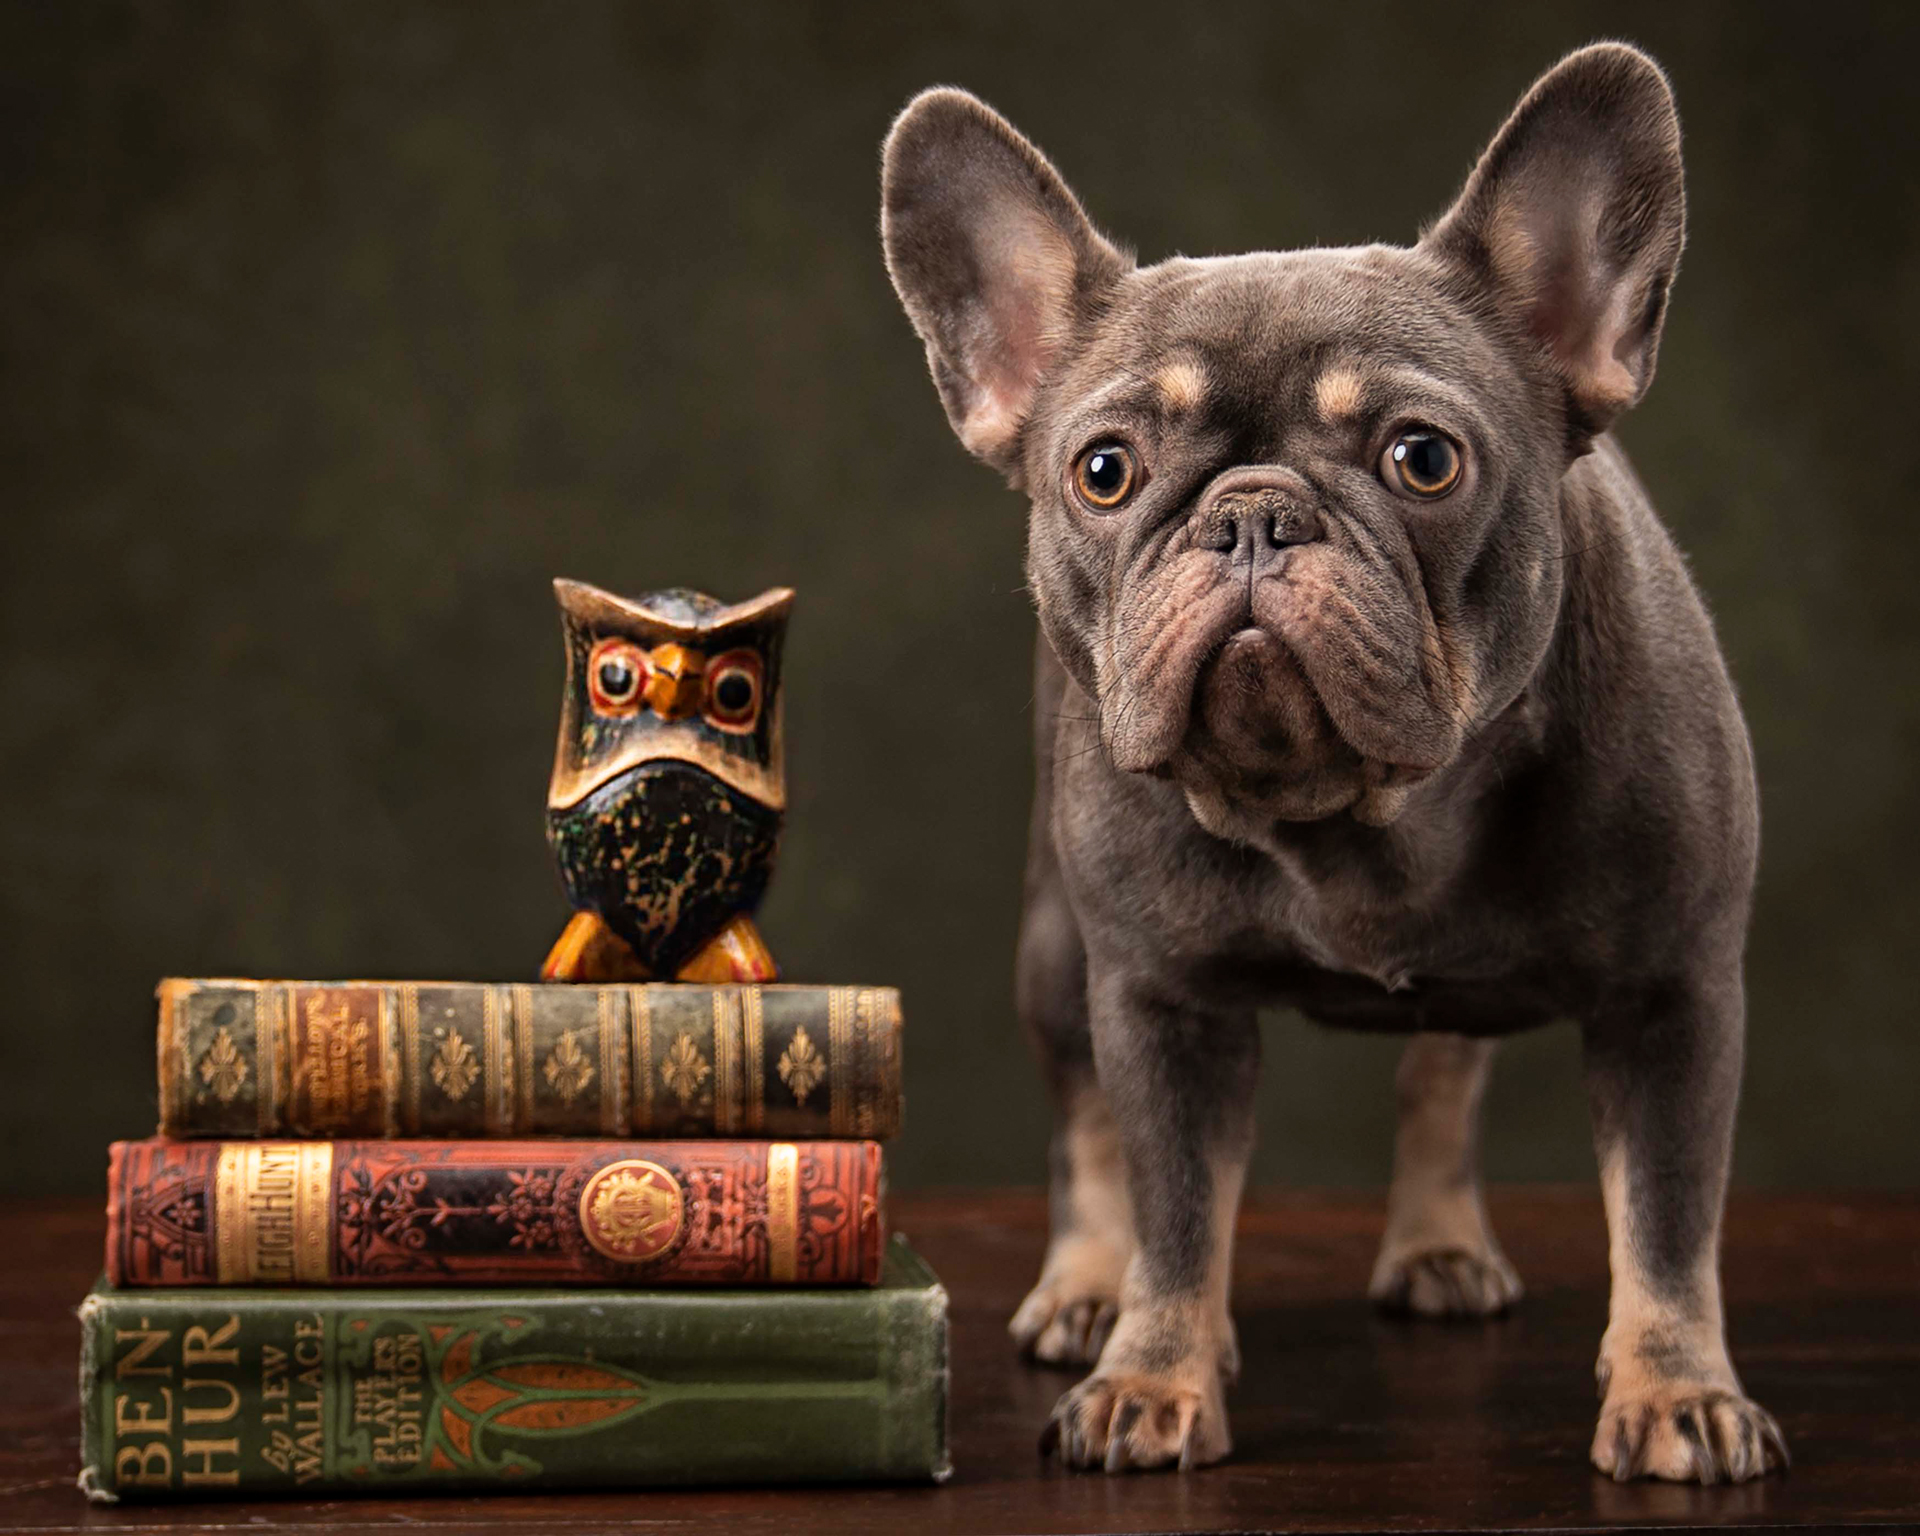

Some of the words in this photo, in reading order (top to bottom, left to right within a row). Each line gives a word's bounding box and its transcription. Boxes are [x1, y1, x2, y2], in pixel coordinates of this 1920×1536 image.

[183, 1314, 241, 1487] HUR
[261, 1344, 290, 1423] LEW
[294, 1312, 325, 1485] WALLACE
[354, 1379, 371, 1423] THE
[397, 1334, 422, 1464] EDITION
[260, 1430, 297, 1473] by
